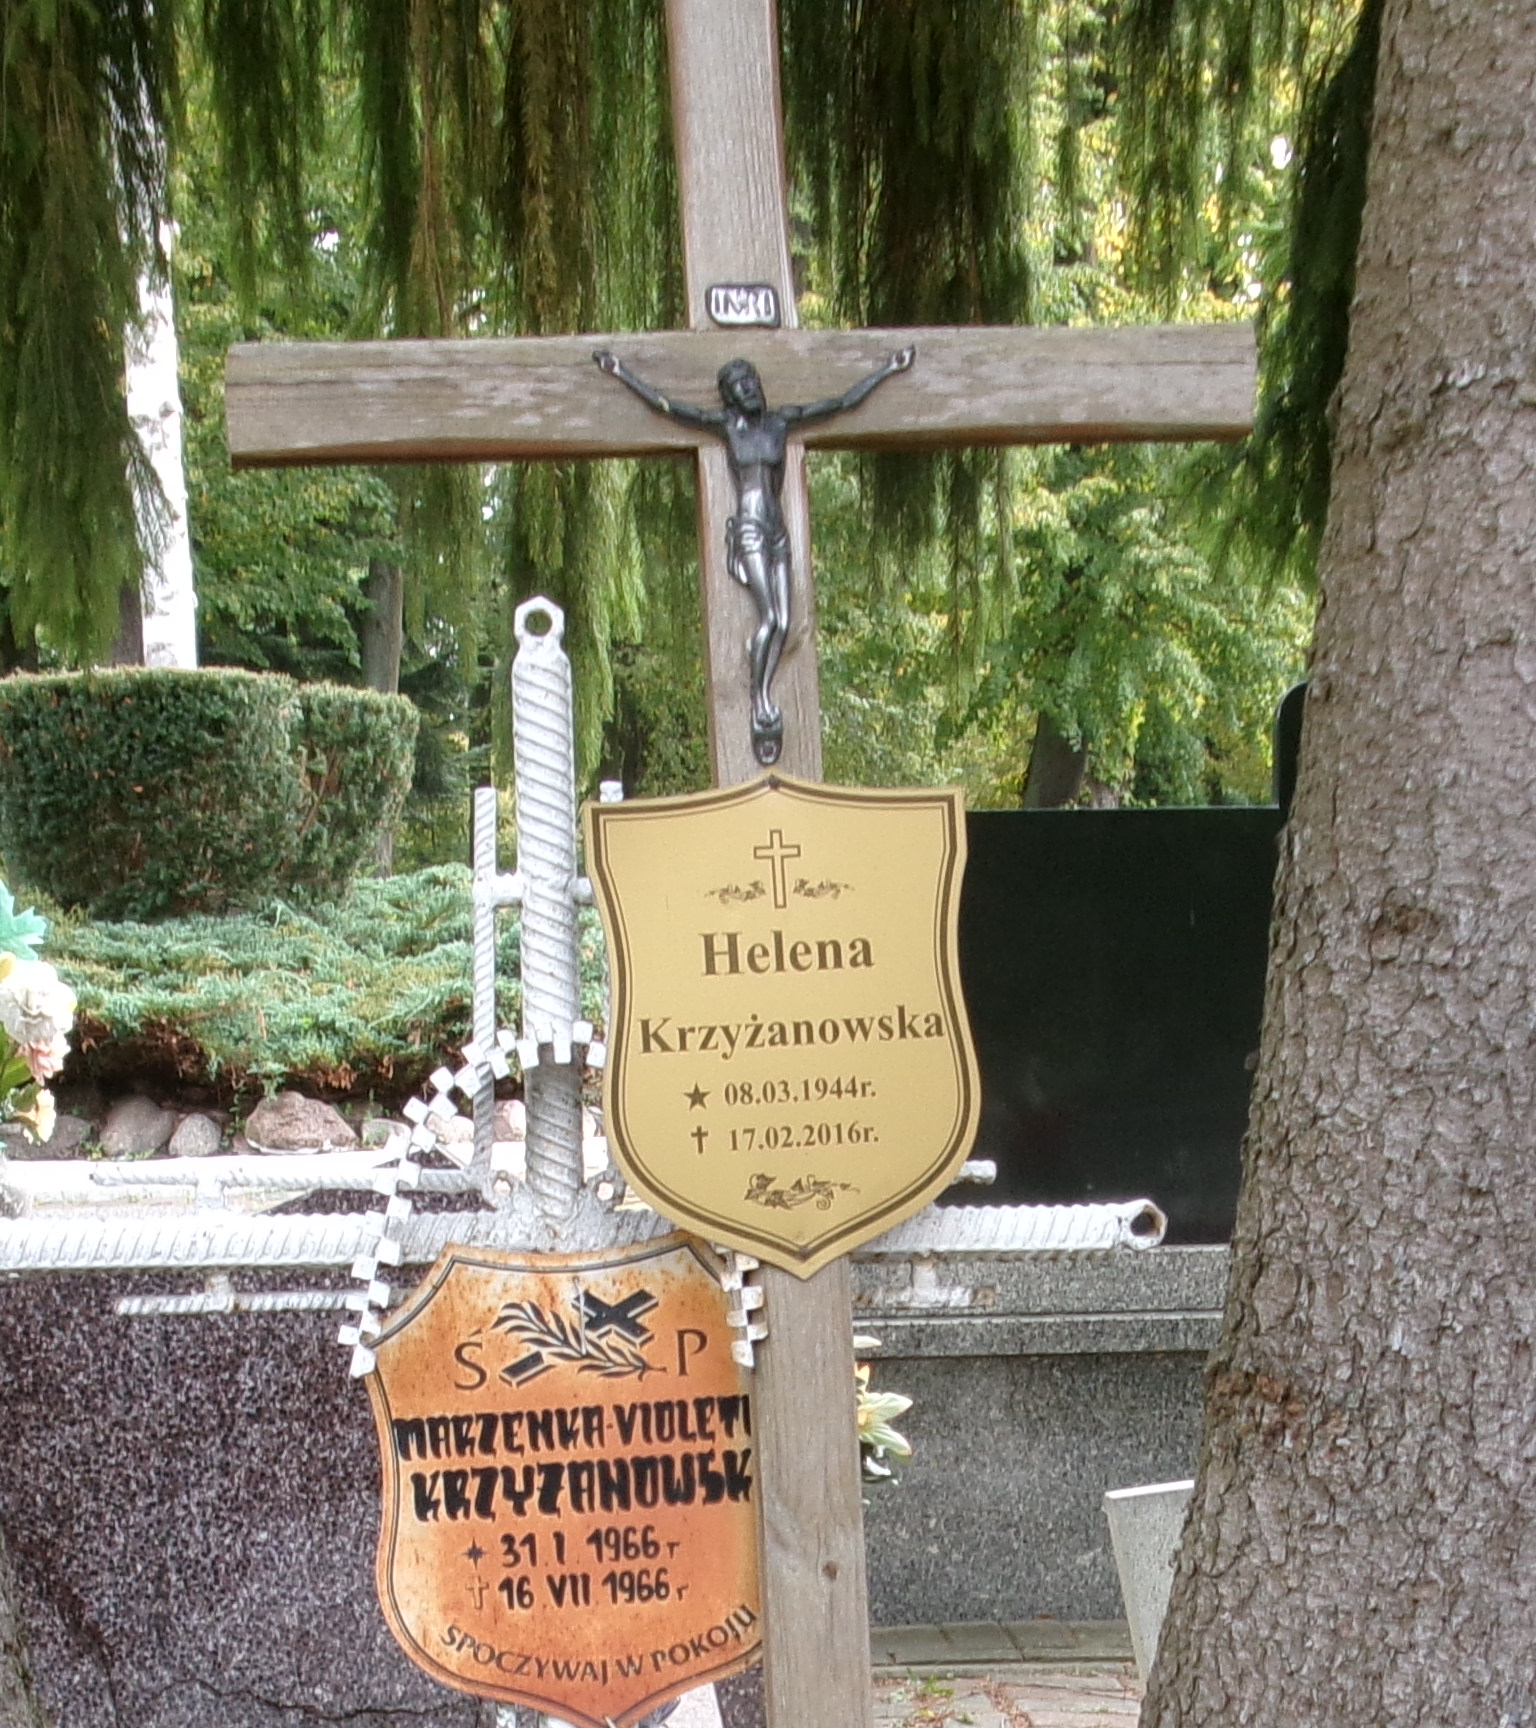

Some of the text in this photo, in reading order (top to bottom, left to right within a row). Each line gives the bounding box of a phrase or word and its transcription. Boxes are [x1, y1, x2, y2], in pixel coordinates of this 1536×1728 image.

[714, 289, 772, 318] INRI
[699, 930, 875, 976] Helena
[638, 1005, 946, 1060] Krzyżanowska
[724, 1076, 877, 1106] 08.03.1944r.
[728, 1121, 880, 1152] 17.02.2016r.
[675, 1329, 708, 1378] P
[440, 1604, 758, 1687] SPOCZYWAJ W POKOJU
